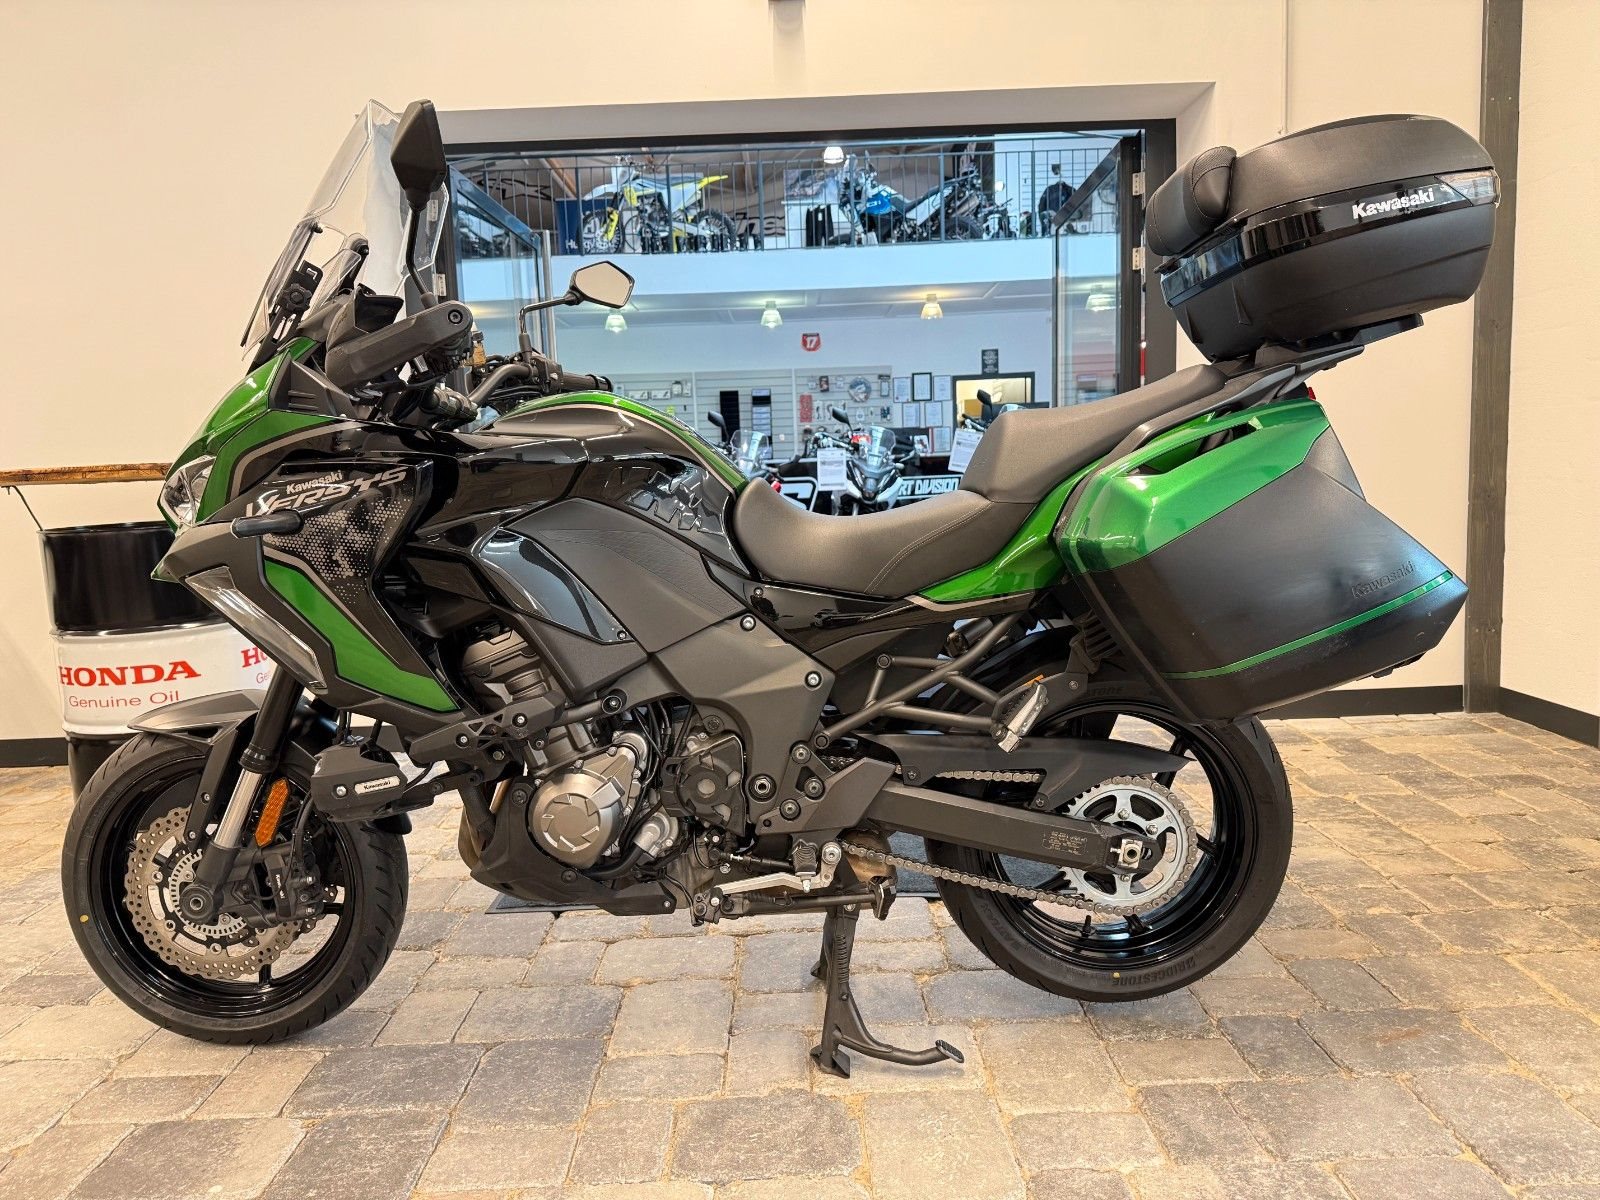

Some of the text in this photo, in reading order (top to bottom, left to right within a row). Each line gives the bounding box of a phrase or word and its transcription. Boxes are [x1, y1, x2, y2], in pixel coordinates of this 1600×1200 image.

[1352, 188, 1435, 219] Kawasaki
[245, 466, 409, 517] VERSYS
[286, 470, 343, 495] Kawasaki
[1350, 560, 1416, 600] Kawasaki
[58, 660, 202, 688] HONDA
[68, 690, 180, 709] Genuine Oil
